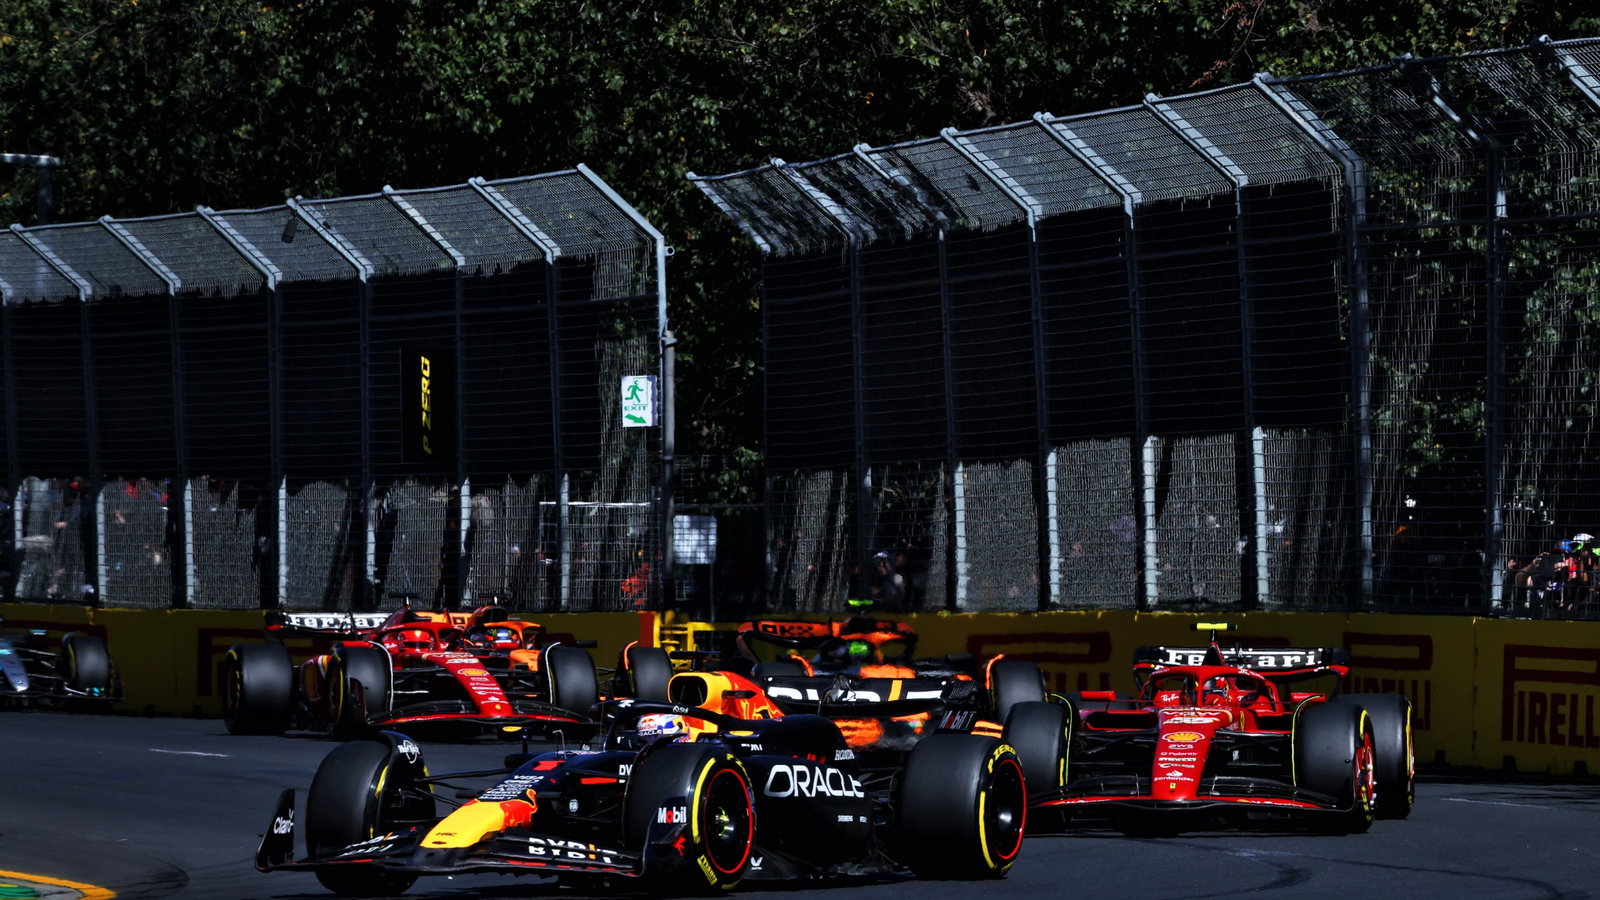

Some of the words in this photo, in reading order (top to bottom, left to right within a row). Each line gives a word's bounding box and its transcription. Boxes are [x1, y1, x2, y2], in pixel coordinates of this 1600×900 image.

[420, 355, 432, 431] ZERO
[422, 434, 433, 455] P
[1164, 649, 1317, 667] Feari
[1502, 644, 1600, 748] PIRELL
[940, 710, 969, 729] Mobil
[834, 749, 855, 761] HONDA
[993, 744, 1017, 761] ZERO
[763, 764, 865, 798] ORACLE
[657, 806, 687, 823] Mobil
